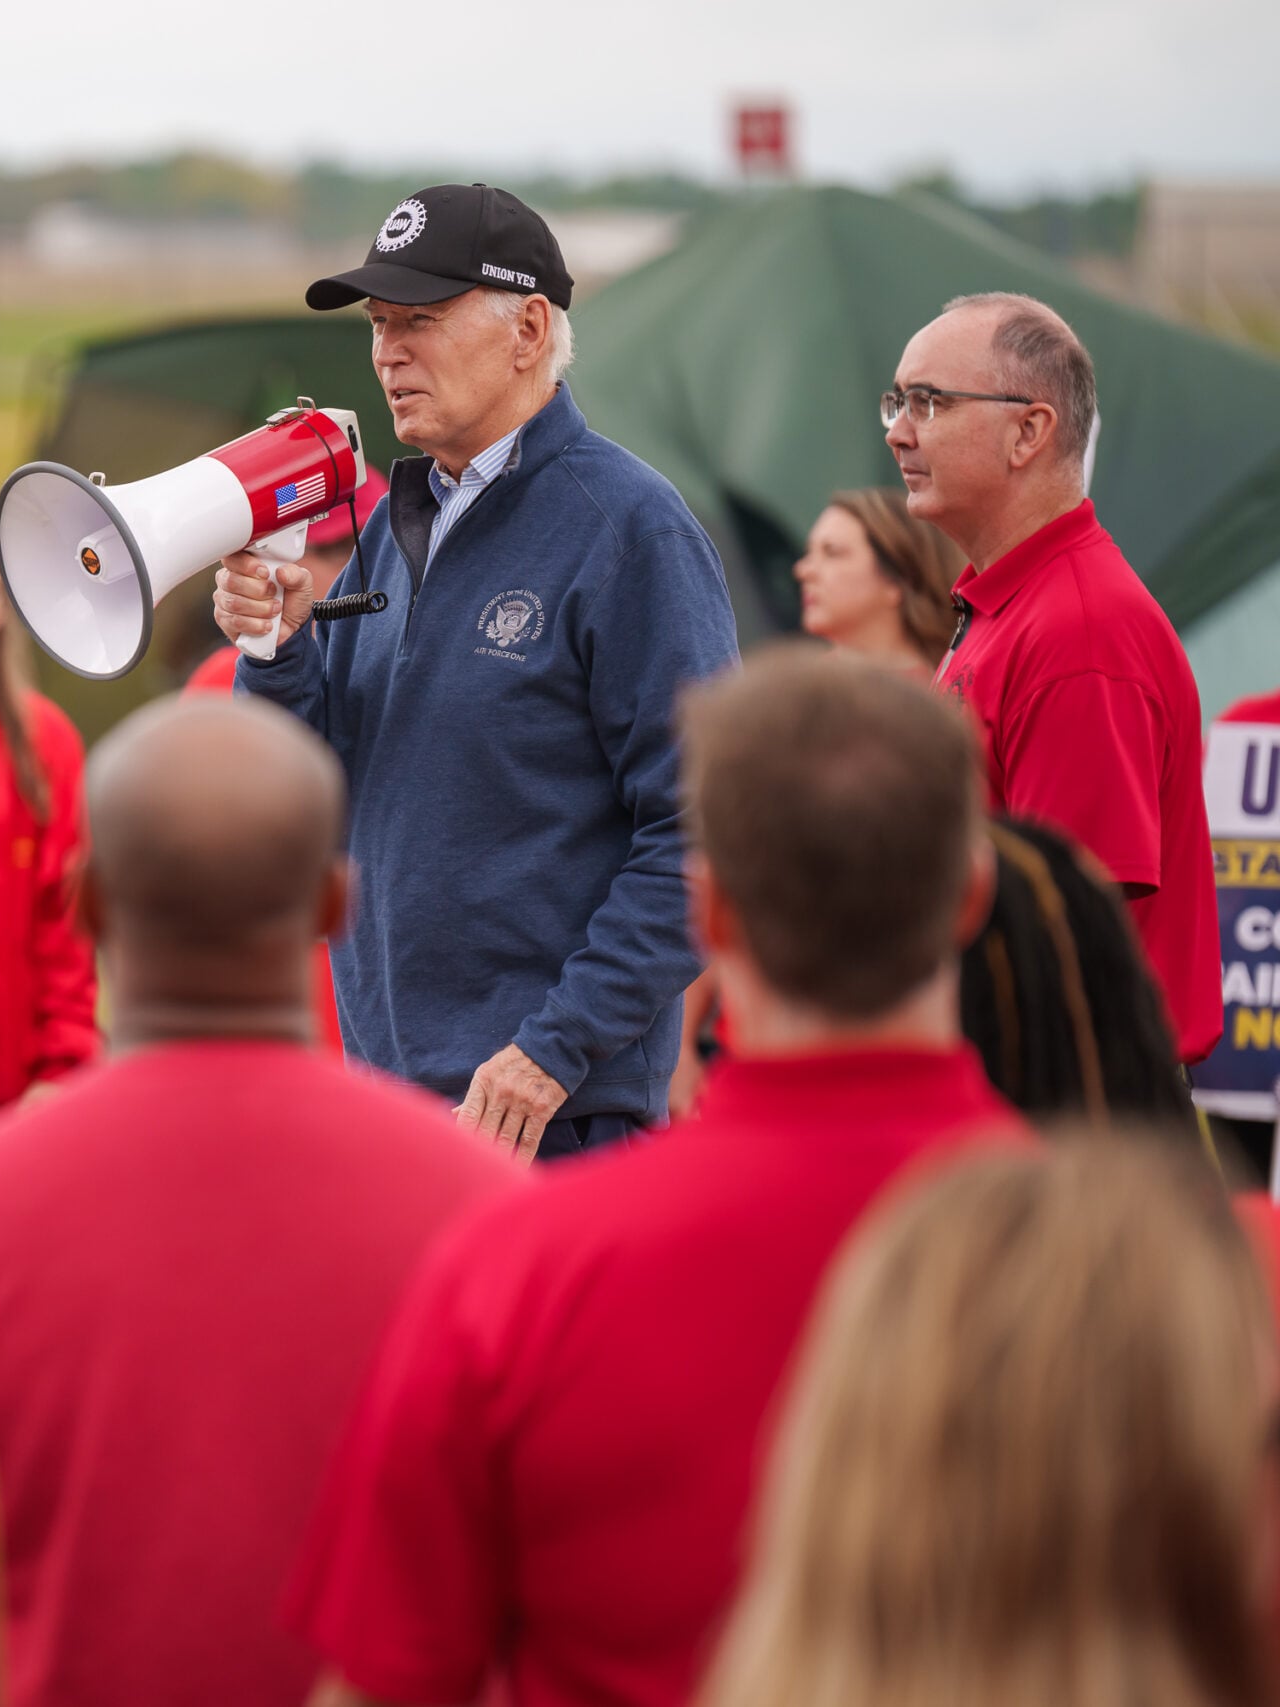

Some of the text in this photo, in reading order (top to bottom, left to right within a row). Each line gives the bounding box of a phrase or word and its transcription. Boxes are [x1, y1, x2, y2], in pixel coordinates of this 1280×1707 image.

[387, 217, 412, 232] UAW
[481, 262, 537, 289] UNION YES
[477, 592, 505, 630] PRESIDENT
[524, 590, 543, 610] UNITED
[531, 611, 545, 640] STATES
[473, 646, 528, 662] AIR FORCE ONE
[1234, 904, 1280, 952] C
[1234, 1005, 1280, 1051] N
